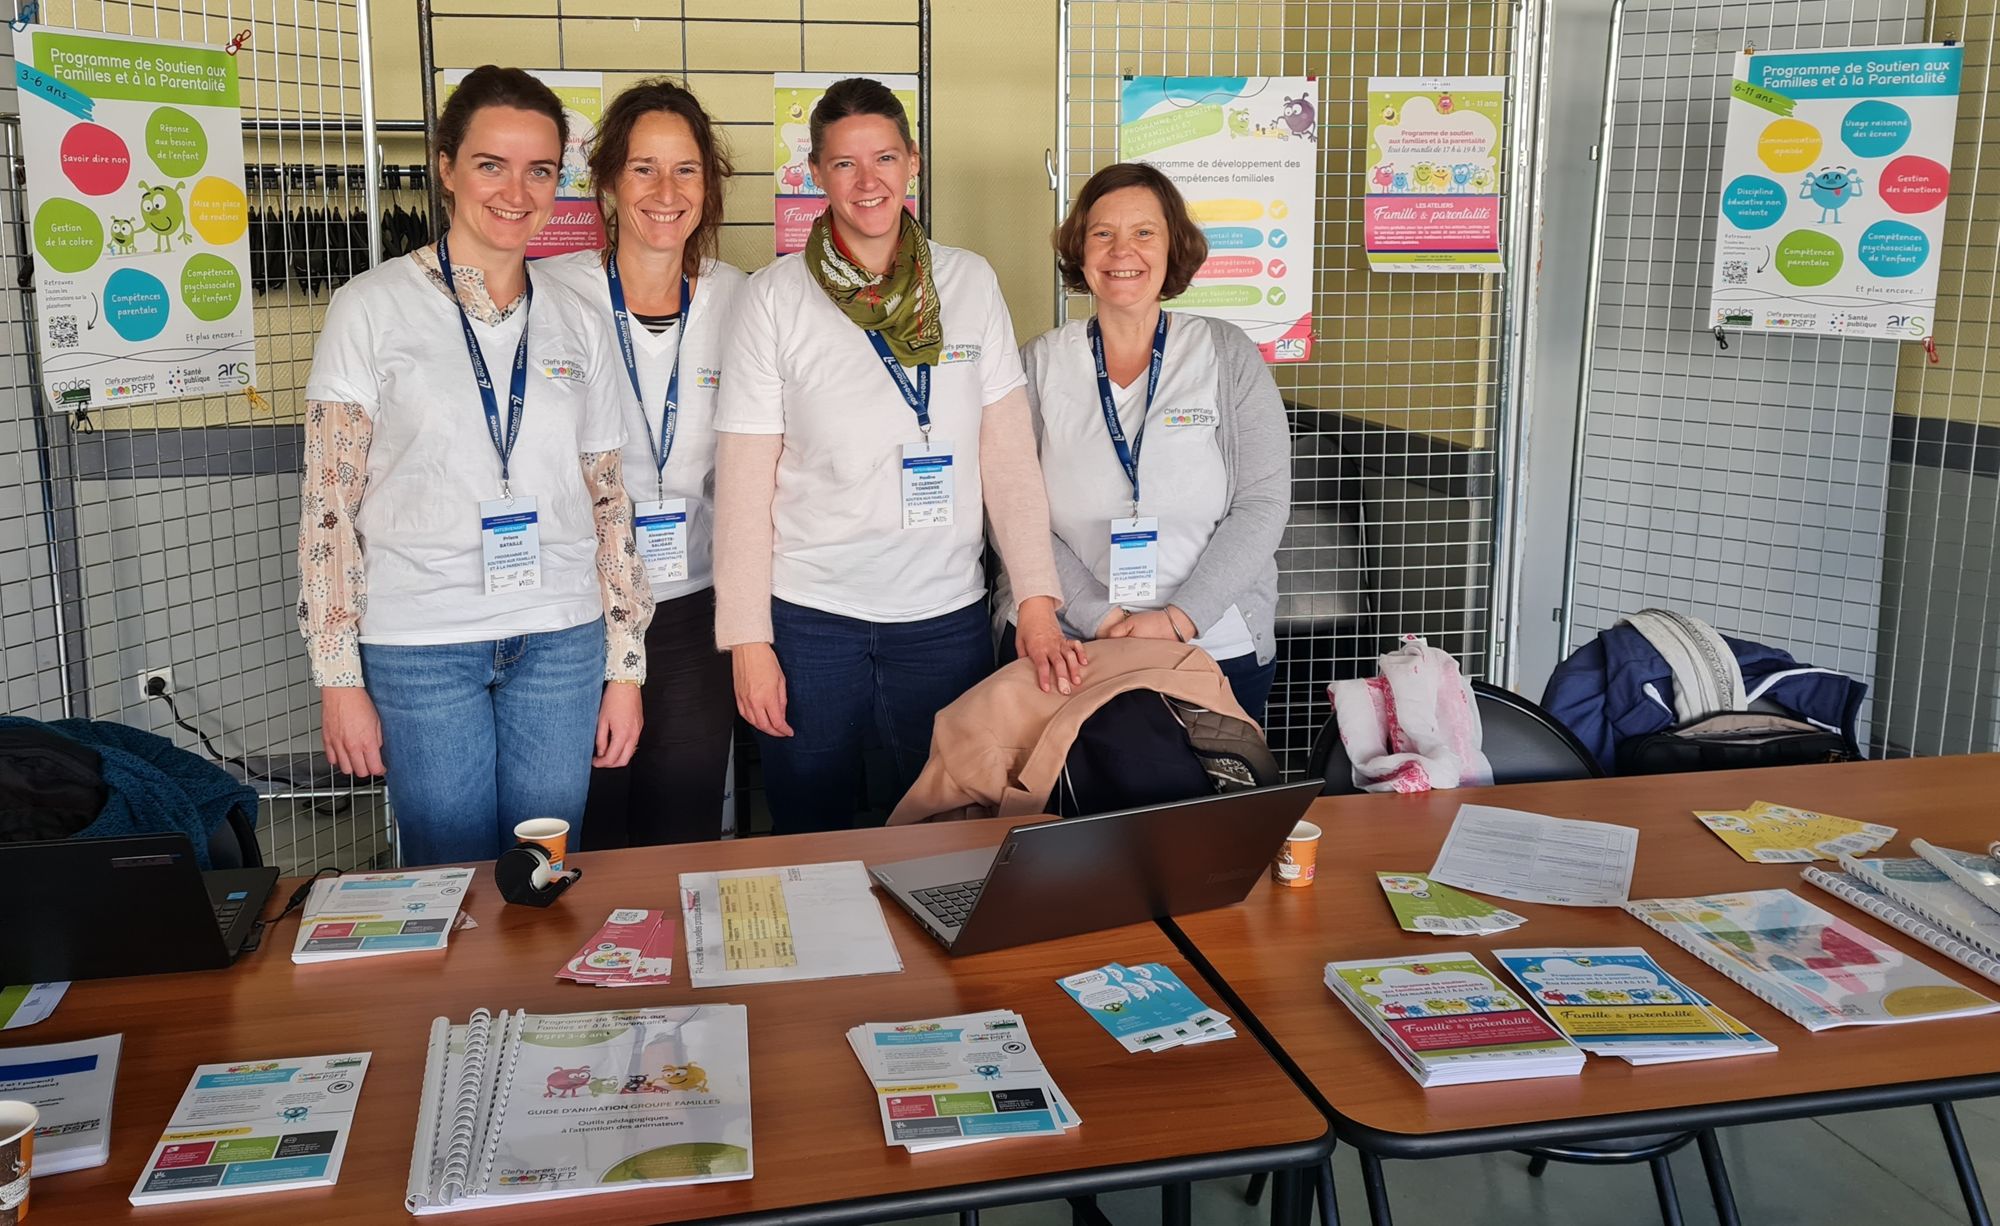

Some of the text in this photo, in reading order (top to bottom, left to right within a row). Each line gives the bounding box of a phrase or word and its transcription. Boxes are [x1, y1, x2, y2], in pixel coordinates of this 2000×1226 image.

[50, 48, 227, 77] Programme de Soutien aux
[1763, 62, 1950, 78] Programme de Soutien aux
[53, 66, 226, 92] Familles et à la Parentalité
[1763, 72, 1946, 89] Familles et à la Parentalité
[21, 70, 67, 99] 3-6 ans
[1734, 83, 1774, 104] 6-11 ans
[1846, 118, 1907, 128] Usage raisonné
[160, 123, 189, 134] Réponse
[1853, 129, 1897, 138] des écrans
[170, 139, 196, 147] besoins
[1450, 137, 1486, 145] parentalité
[63, 154, 128, 164] Savoir dire non
[158, 151, 199, 161] de l'enfant
[1197, 158, 1300, 170] de développement des
[1168, 173, 1275, 184] compétences familiales
[1897, 174, 1929, 183] Gestion
[1737, 188, 1774, 197] Discipline
[1886, 185, 1942, 194] des émotions
[1727, 198, 1763, 206] éducative
[1374, 206, 1417, 220] Famille
[1430, 207, 1490, 223] parentalité
[1738, 209, 1769, 217] violente
[51, 224, 82, 233] Gestion
[46, 237, 94, 246] de la colère
[1868, 233, 1922, 242] Compétences
[1784, 248, 1835, 257] Compétences
[1862, 244, 1922, 254] psychosociales
[1787, 259, 1829, 268] parentales
[1868, 254, 1917, 264] de l'enfant
[187, 268, 234, 279] Compétences
[185, 279, 235, 293] psychosociales
[1867, 285, 1883, 295] plus
[112, 292, 161, 304] Compétences
[192, 293, 232, 304] de l'enfant
[118, 305, 158, 319] parentales
[1847, 313, 1868, 321] Santé
[1791, 319, 1816, 327] PSFP
[1847, 321, 1877, 329] publique
[186, 333, 210, 343] Et plus
[183, 368, 201, 376] Santé
[183, 375, 210, 385] publique
[52, 378, 91, 393] codes
[131, 383, 156, 394] PSFP
[1192, 415, 1215, 423] PSFP
[1560, 1011, 1611, 1019] Famille
[1628, 1011, 1694, 1020] parentalité
[1402, 1024, 1451, 1033] Famille
[1469, 1017, 1533, 1031] parentalité
[561, 1105, 628, 1114] D'ANIMATION
[631, 1101, 671, 1110] GROUPE
[674, 1099, 721, 1107] FAMILLES
[606, 1115, 669, 1125] pédagogiques
[569, 1125, 615, 1133] l'attention
[634, 1120, 684, 1129] animateurs
[538, 1171, 577, 1181] PSFP
